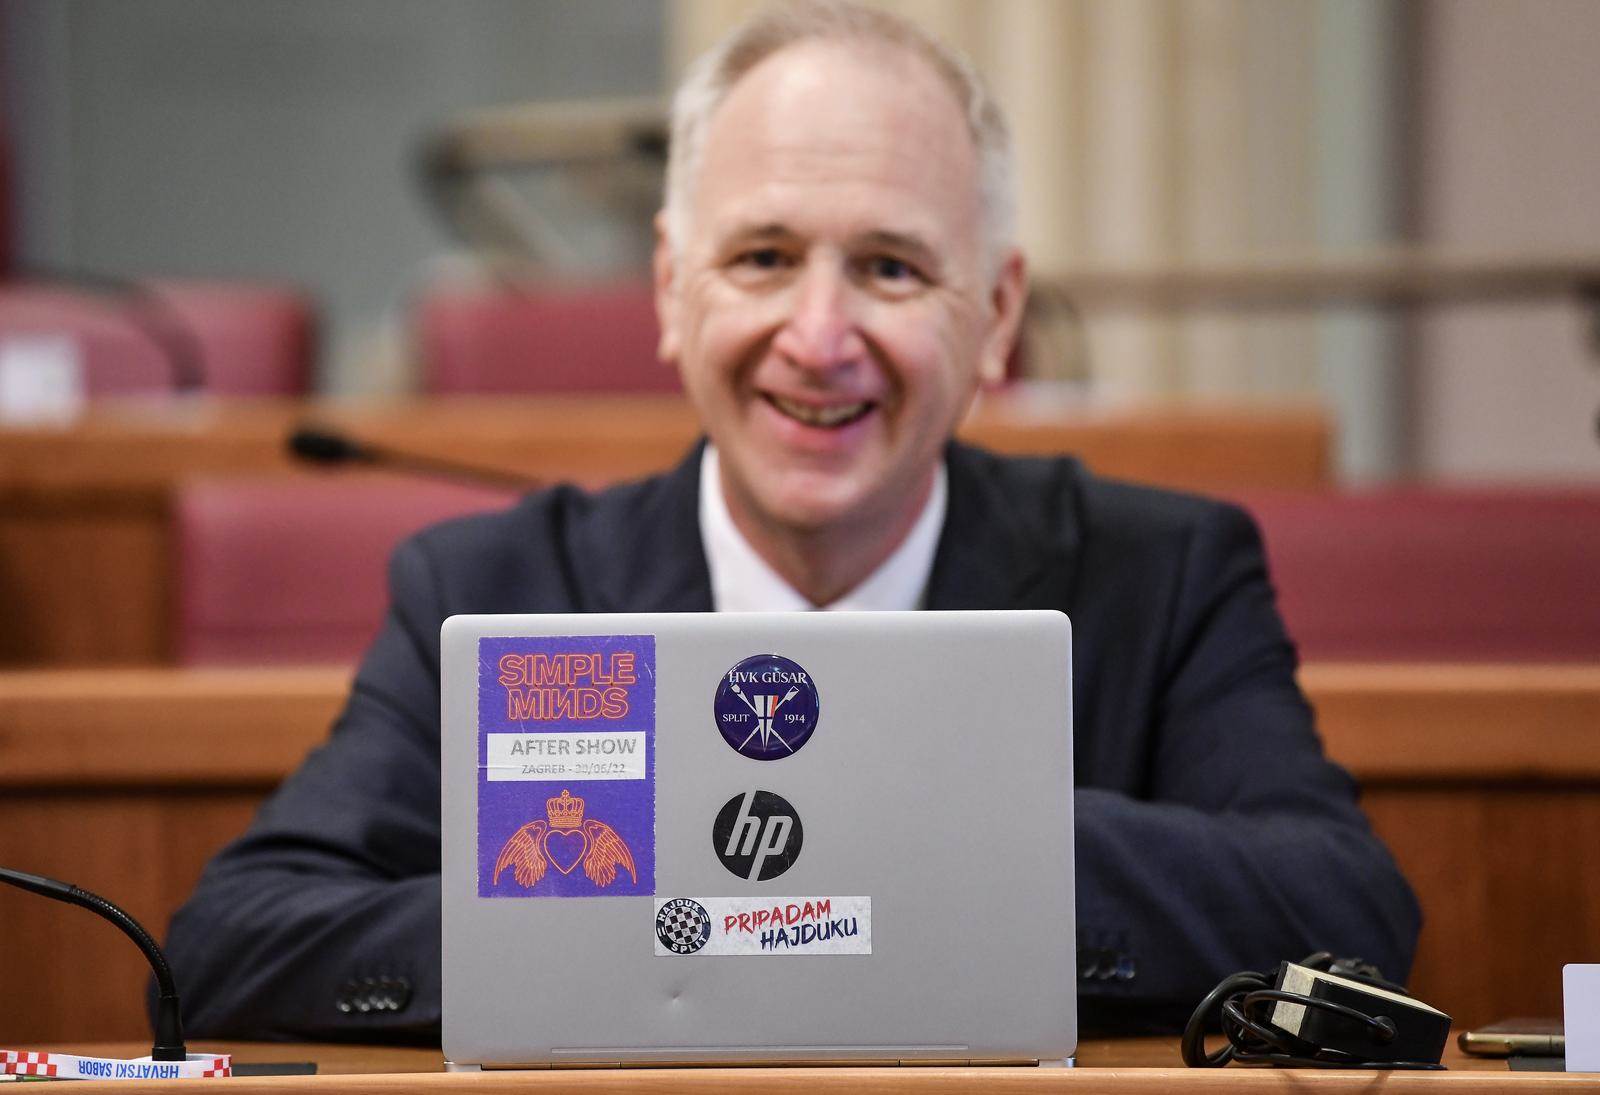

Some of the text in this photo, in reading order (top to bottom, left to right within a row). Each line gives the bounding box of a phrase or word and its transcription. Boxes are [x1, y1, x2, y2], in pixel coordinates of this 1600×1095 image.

[498, 653, 636, 687] SIMPLE
[729, 672, 758, 684] HVK
[722, 713, 806, 724] SPLIT 1914
[511, 738, 636, 756] AFTER SHOW
[521, 764, 565, 775] ZAGREB
[724, 790, 794, 881] hp
[657, 899, 701, 922] HAJDUK
[724, 898, 831, 935] PRIPADAM
[760, 917, 858, 952] HAJDUKU
[671, 936, 709, 954] SPLIT
[78, 1060, 179, 1078] HRVATSKI SABOR
